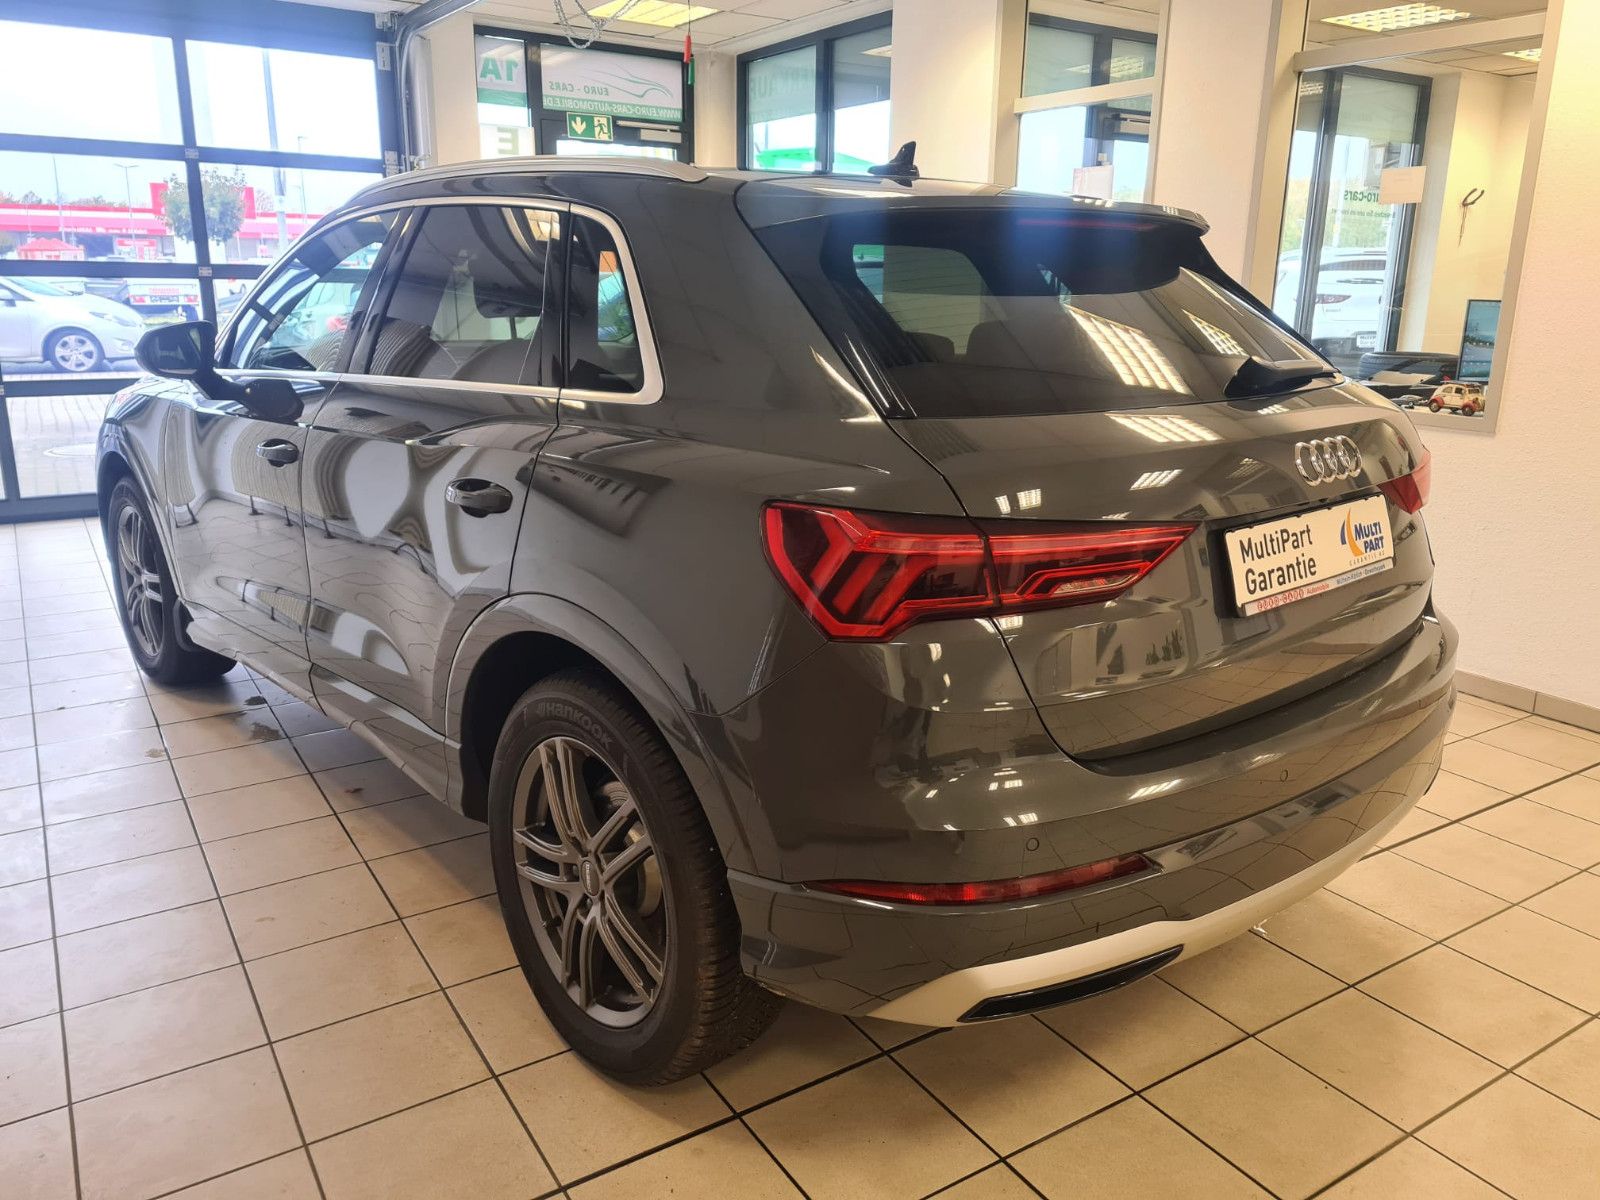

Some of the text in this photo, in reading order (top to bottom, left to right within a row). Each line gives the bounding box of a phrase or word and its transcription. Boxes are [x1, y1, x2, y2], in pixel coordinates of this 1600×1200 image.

[1239, 524, 1313, 563] MultiPart
[1354, 522, 1382, 541] MULTI
[1364, 536, 1384, 553] PART
[1245, 553, 1317, 595] Garantie
